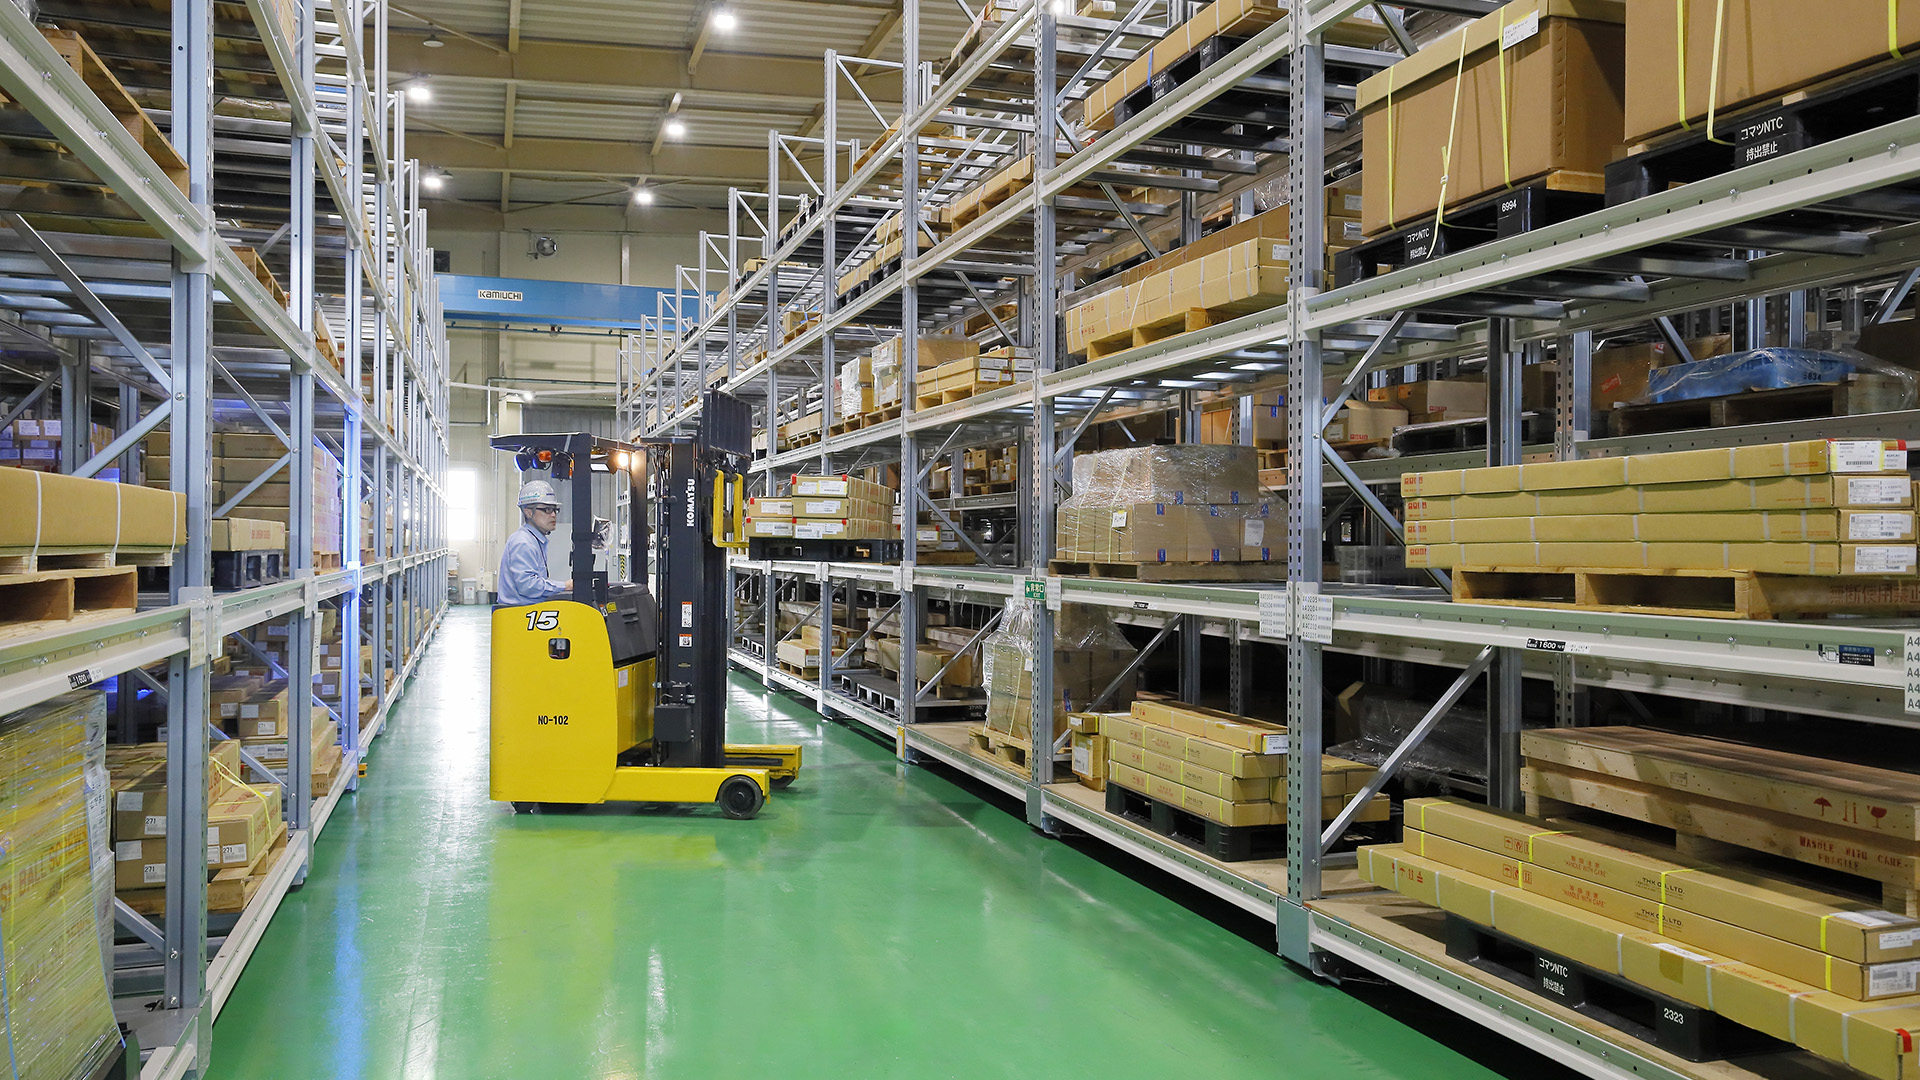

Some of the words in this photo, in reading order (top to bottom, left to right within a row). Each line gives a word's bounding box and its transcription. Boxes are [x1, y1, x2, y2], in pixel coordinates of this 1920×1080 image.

[1741, 116, 1783, 140] コマツNTC
[1746, 141, 1778, 161] 持出禁止
[1407, 228, 1430, 243] コマツNTC
[686, 478, 696, 527] KOMATSU
[526, 611, 559, 631] 15
[538, 716, 569, 725] NO-102
[1642, 877, 1656, 886] THK
[1641, 908, 1655, 918] THK
[1539, 957, 1568, 978] コマツNTC
[1663, 1007, 1684, 1025] 2323
